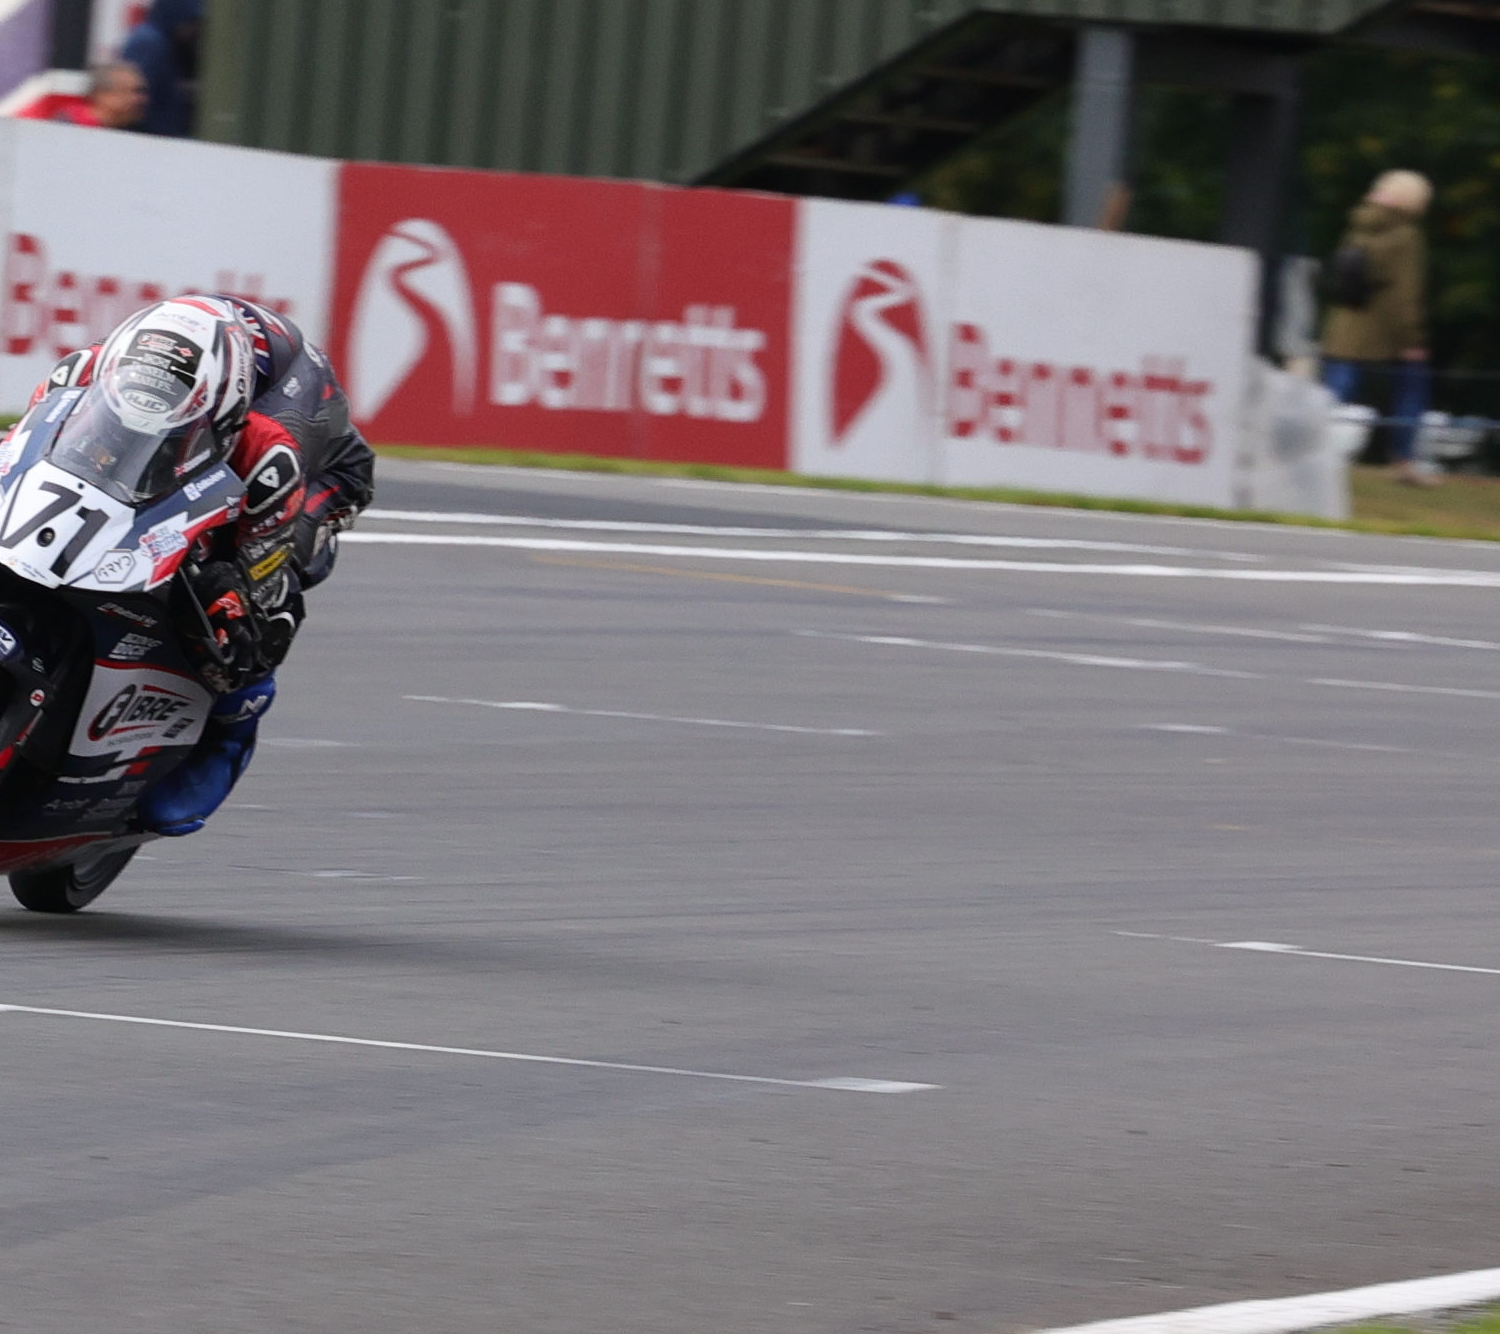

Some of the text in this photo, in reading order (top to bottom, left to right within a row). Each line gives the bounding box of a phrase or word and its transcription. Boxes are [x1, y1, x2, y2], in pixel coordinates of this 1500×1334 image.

[126, 392, 167, 412] HJC
[490, 281, 769, 424] Bennetts
[947, 321, 1213, 465] Bennetts
[0, 481, 110, 579] 71
